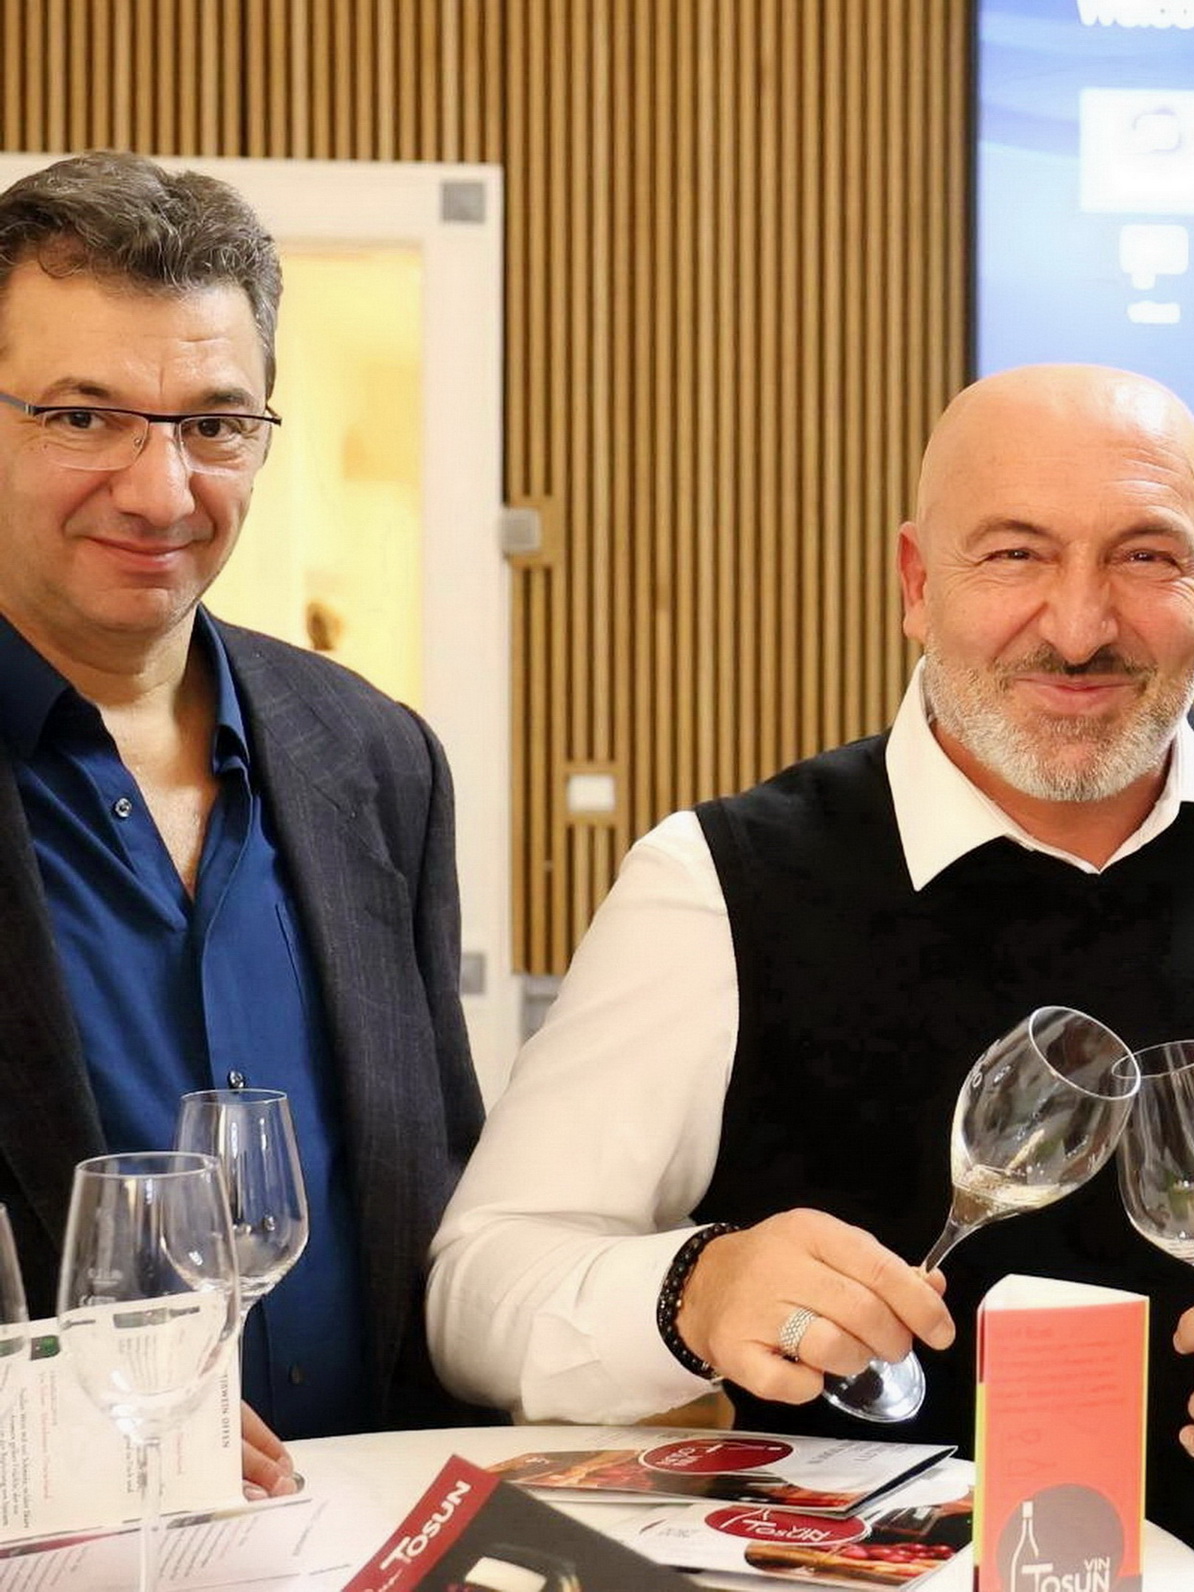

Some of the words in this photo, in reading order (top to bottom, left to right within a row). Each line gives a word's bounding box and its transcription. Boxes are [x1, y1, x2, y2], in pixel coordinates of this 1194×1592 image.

[380, 1480, 471, 1570] TOSUN
[1021, 1562, 1110, 1592] TOSUN
[1083, 1556, 1110, 1571] VIN
